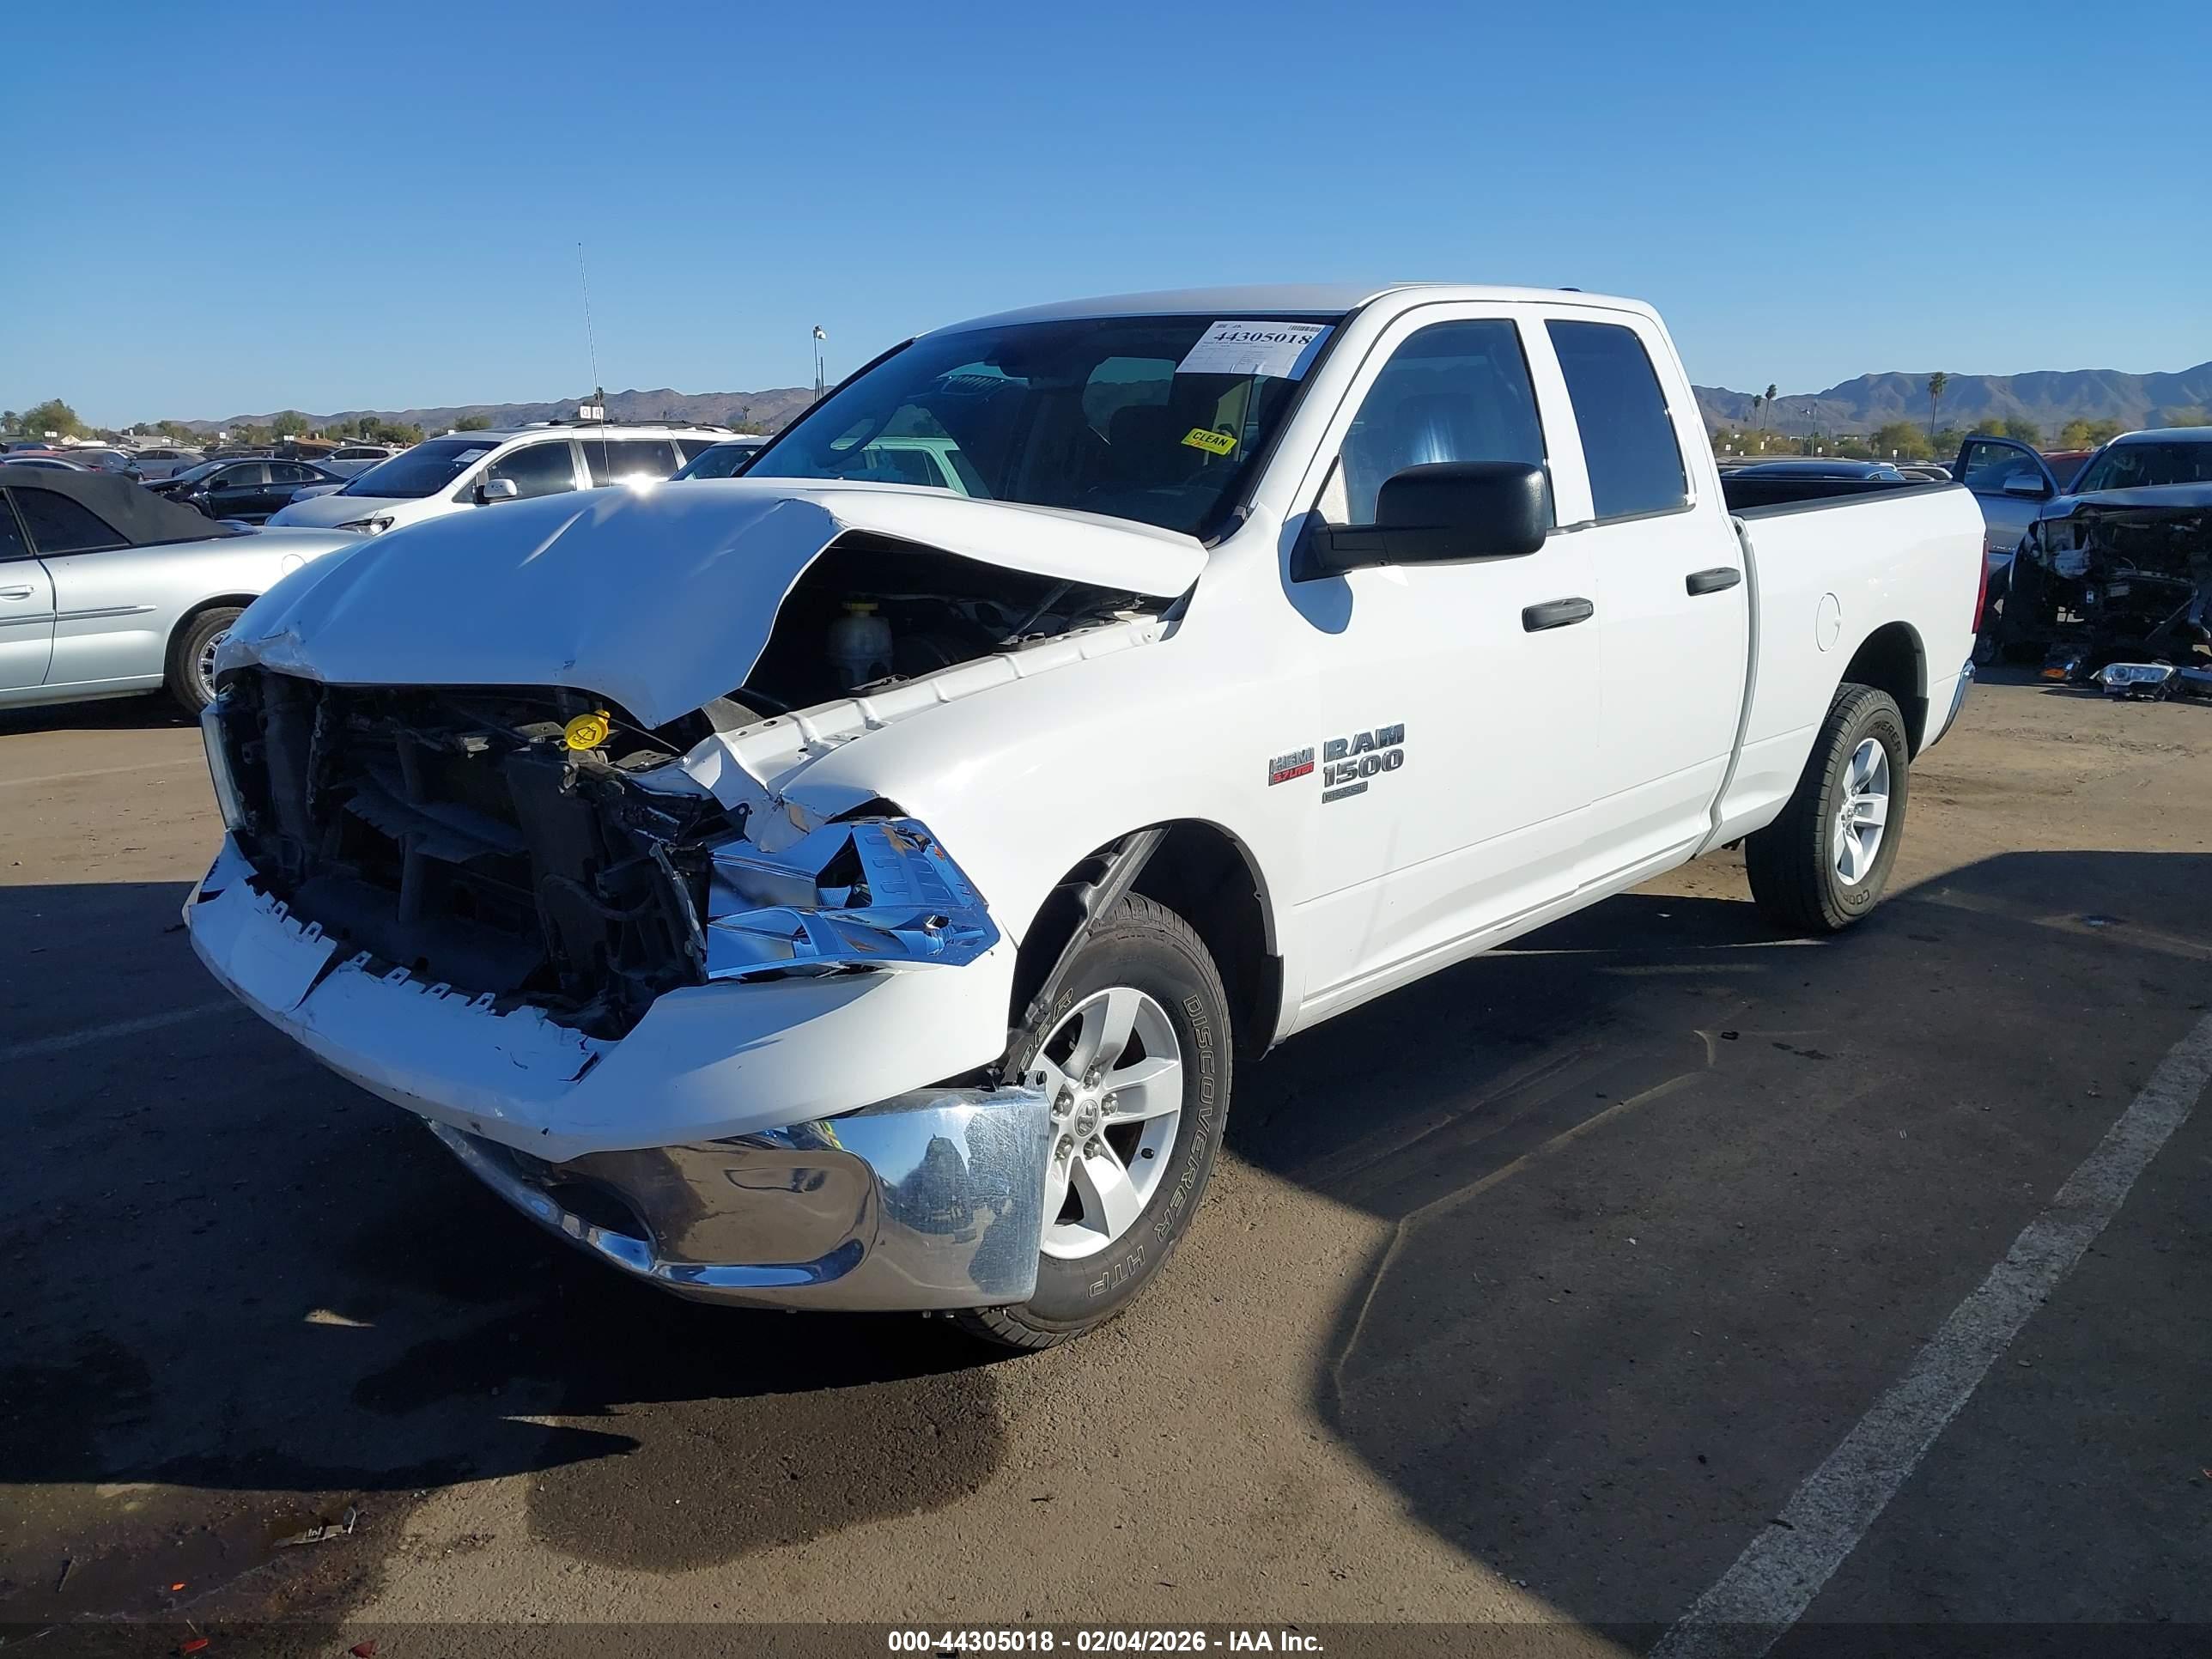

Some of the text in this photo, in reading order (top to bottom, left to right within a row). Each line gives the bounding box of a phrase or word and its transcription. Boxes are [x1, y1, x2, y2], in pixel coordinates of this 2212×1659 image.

[1213, 331, 1313, 345] 44305018
[1192, 431, 1229, 447] CLEAN
[1323, 723, 1405, 763] RAM
[1269, 747, 1315, 773] HEMI
[1273, 763, 1314, 783] 5.7 LITER
[1323, 748, 1405, 787] 1500
[1152, 994, 1215, 1243] DISCOVERER
[1088, 1244, 1146, 1297] HTP
